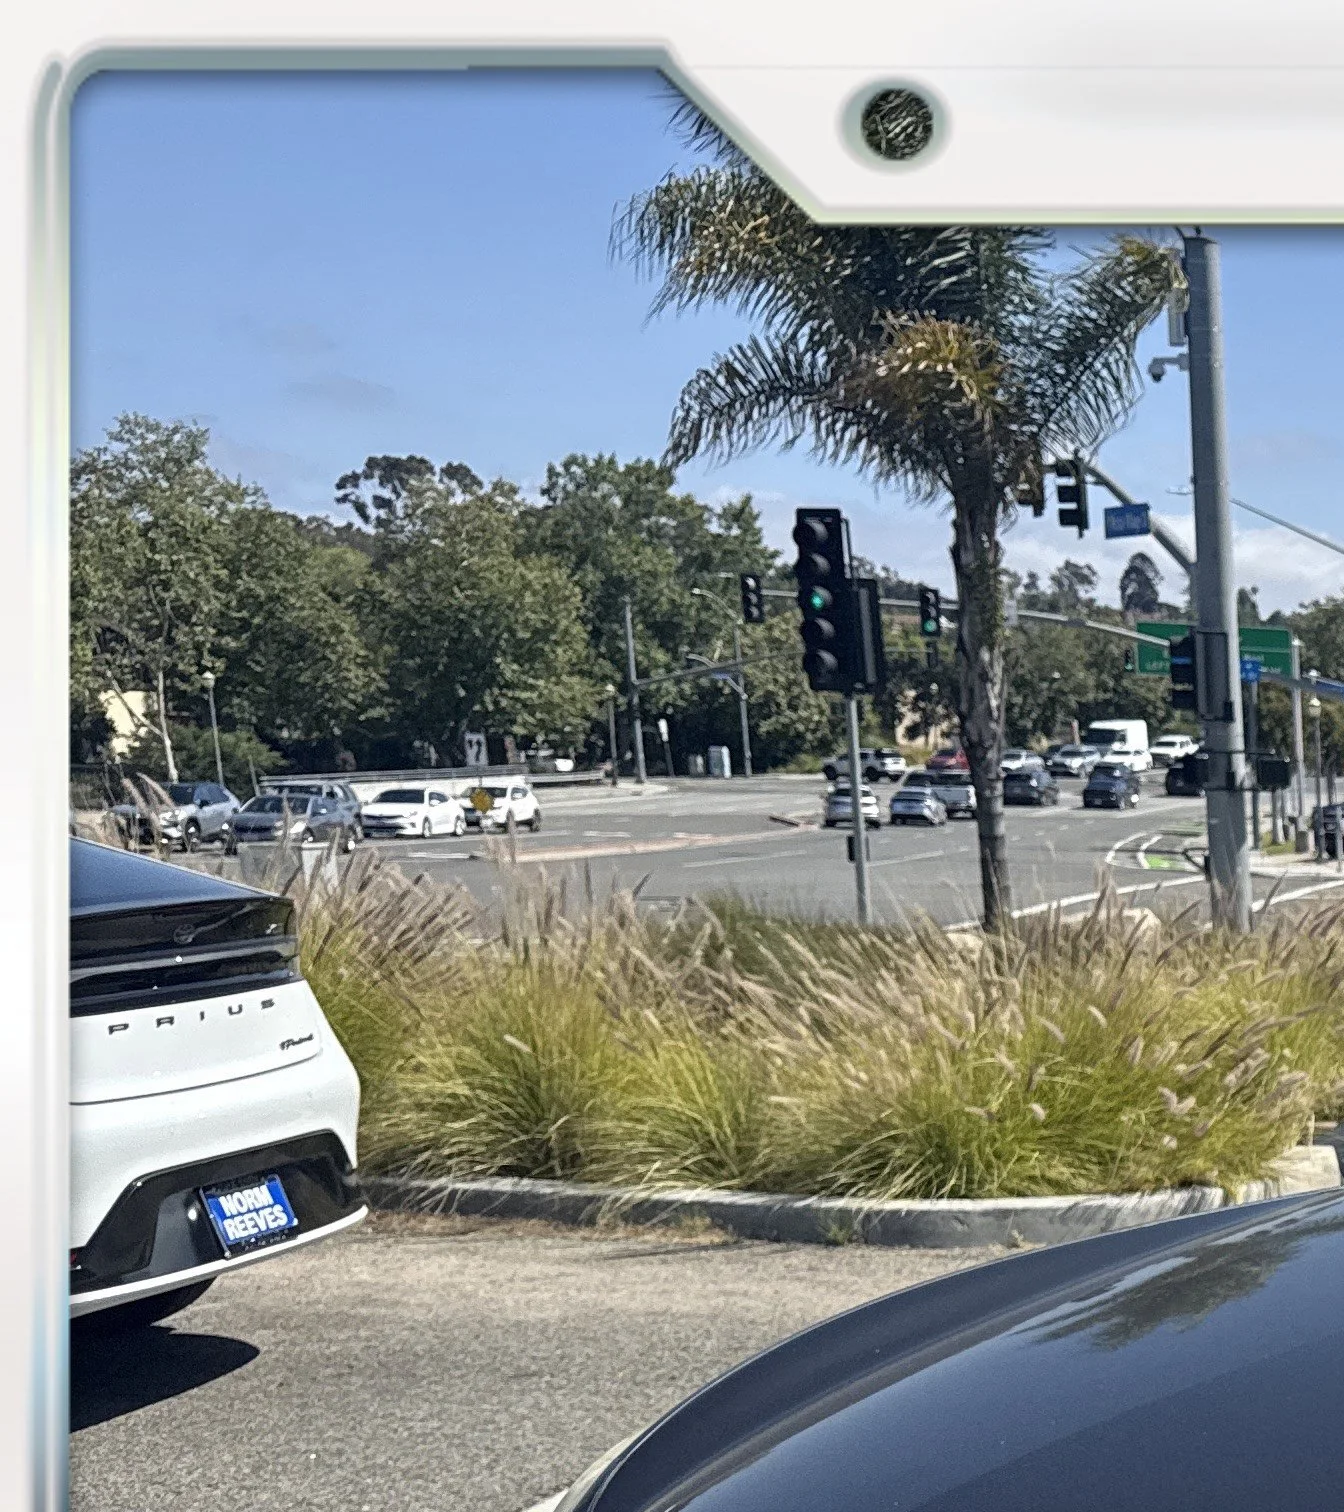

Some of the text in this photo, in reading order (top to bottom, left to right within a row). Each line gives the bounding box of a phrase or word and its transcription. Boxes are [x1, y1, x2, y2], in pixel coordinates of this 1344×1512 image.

[108, 998, 275, 1035] PRIUS
[218, 1184, 275, 1218] NORM
[222, 1203, 289, 1241] REEVES
